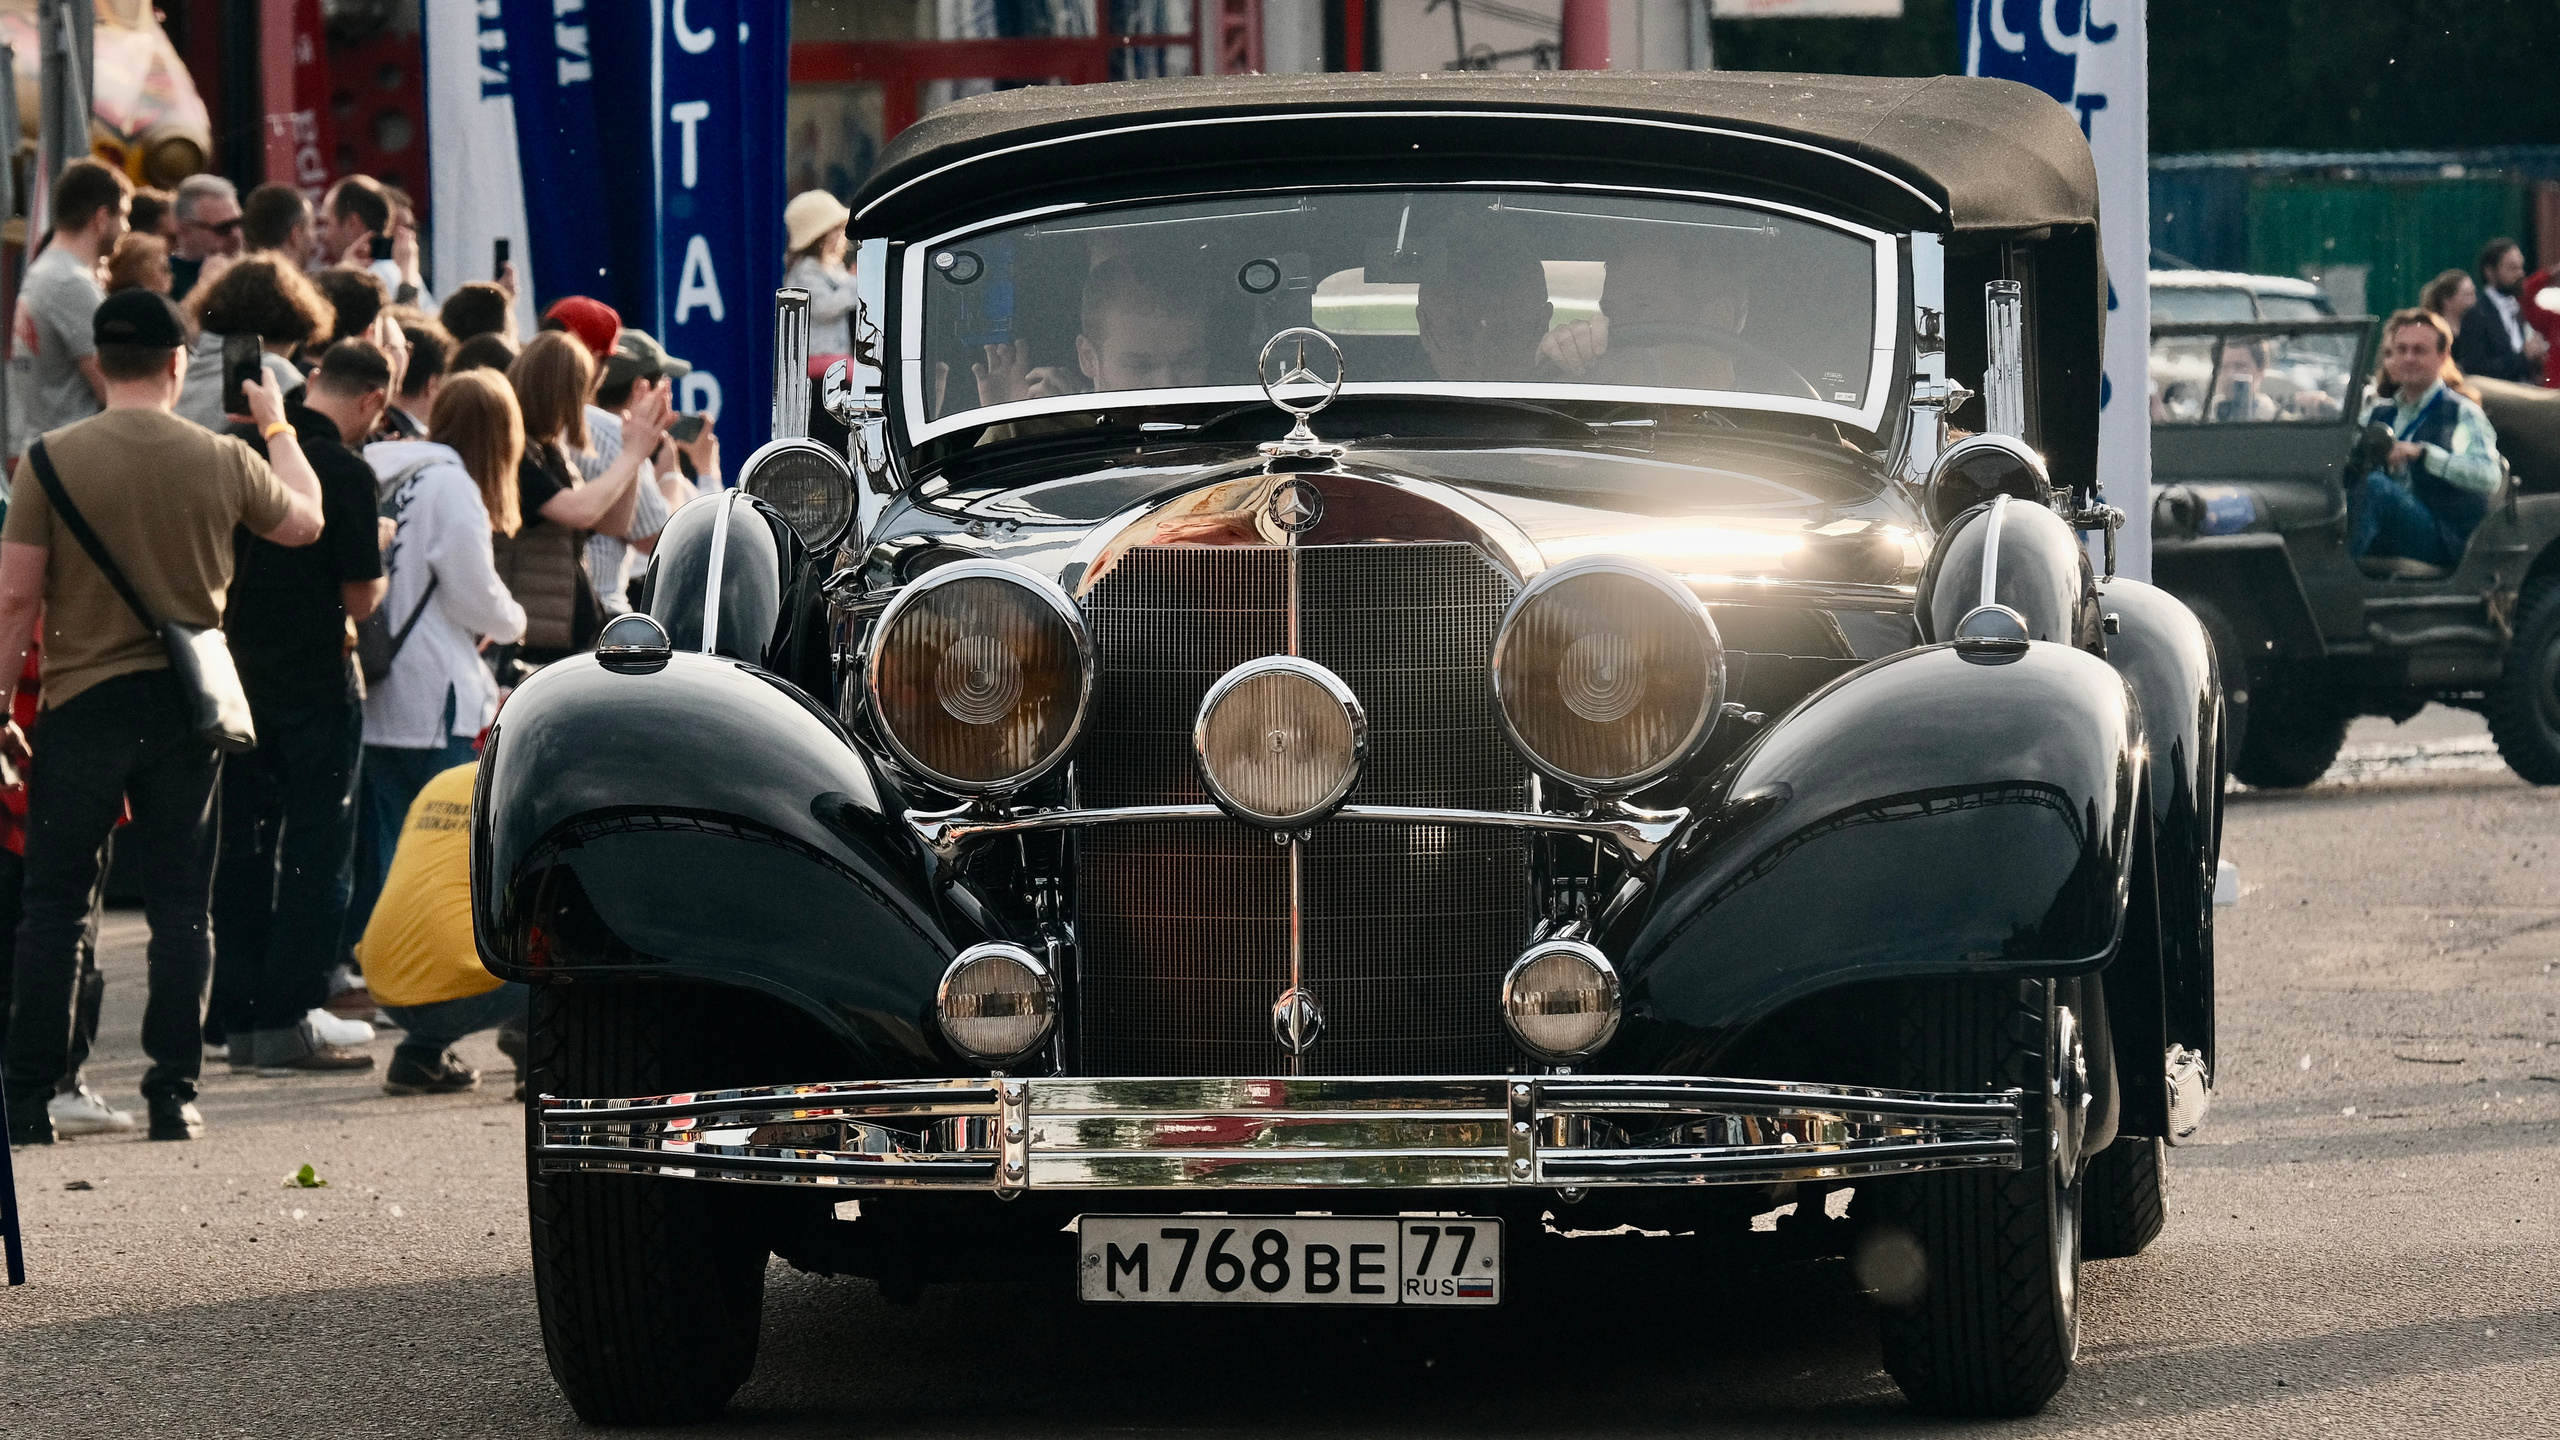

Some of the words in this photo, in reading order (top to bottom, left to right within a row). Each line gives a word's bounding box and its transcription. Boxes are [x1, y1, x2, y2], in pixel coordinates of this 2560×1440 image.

[1283, 523, 1307, 532] BENZ
[1410, 1226, 1476, 1276] 77
[1406, 1278, 1455, 1296] RUS
